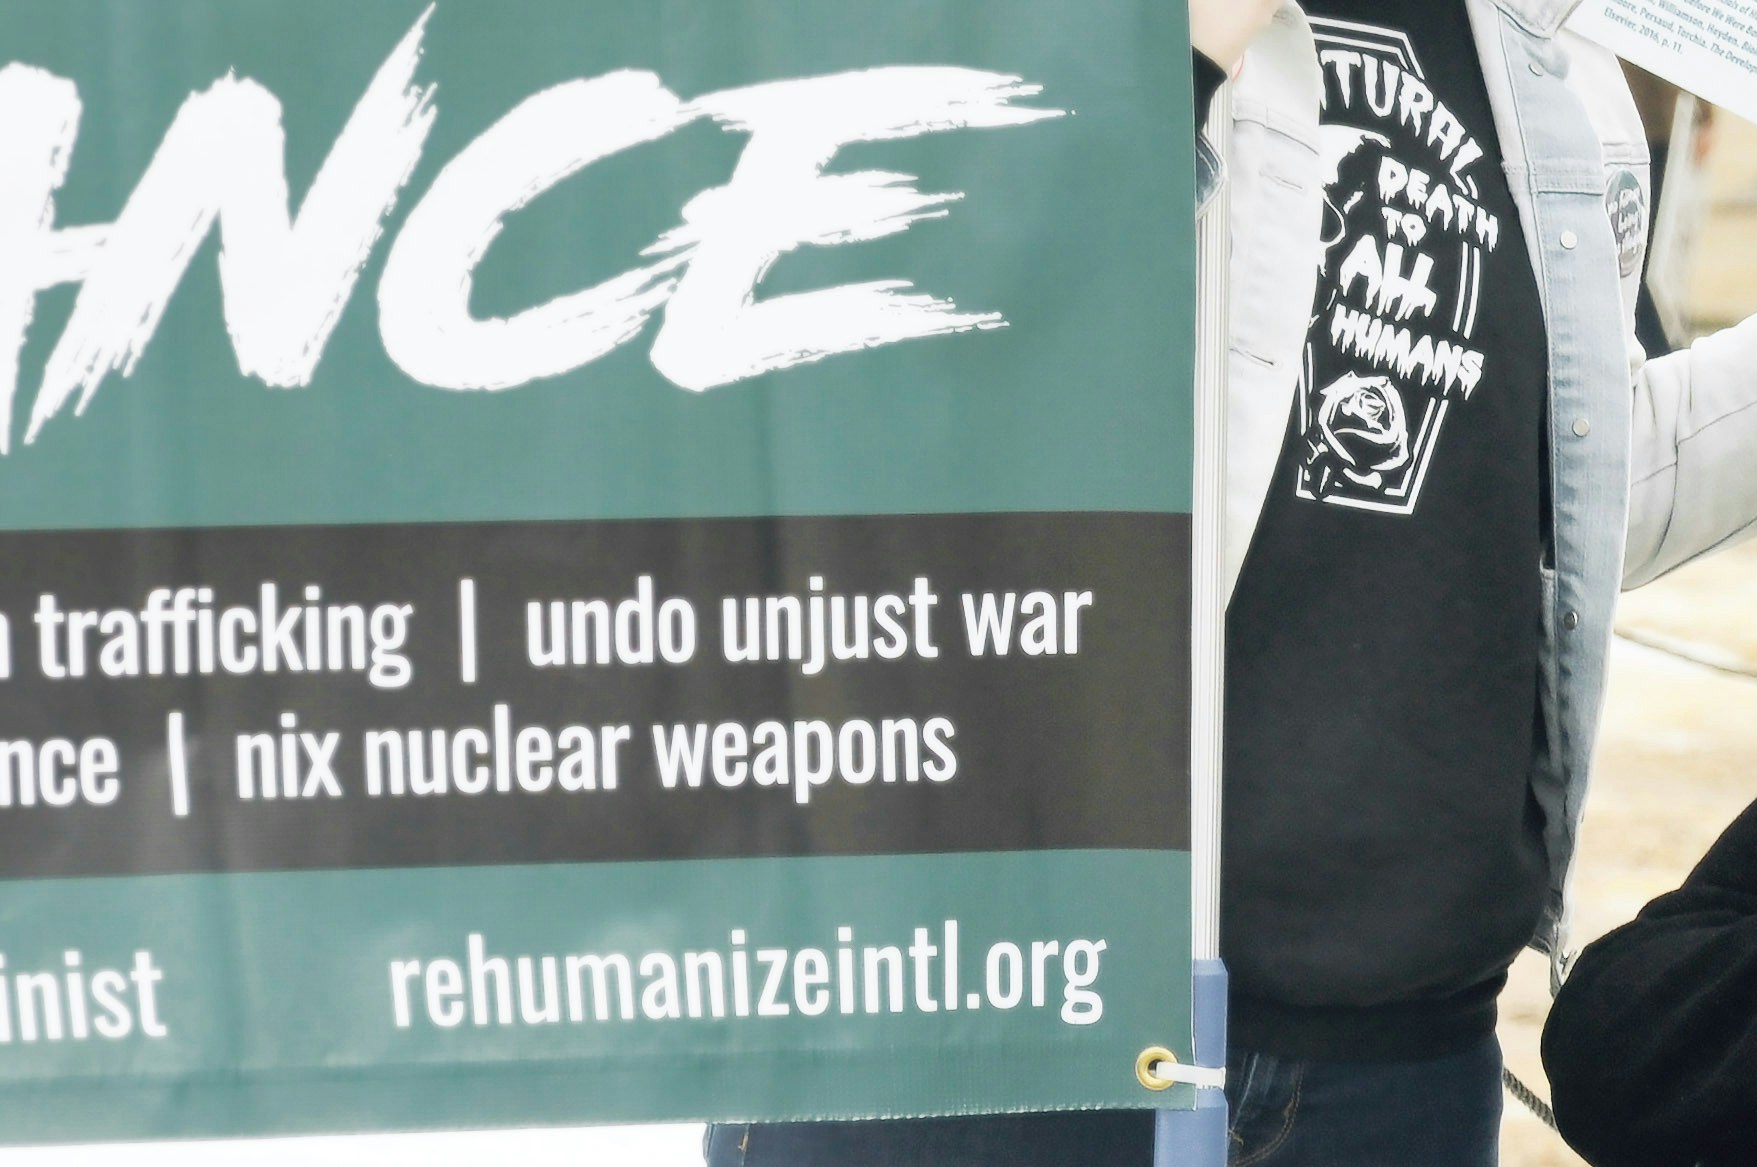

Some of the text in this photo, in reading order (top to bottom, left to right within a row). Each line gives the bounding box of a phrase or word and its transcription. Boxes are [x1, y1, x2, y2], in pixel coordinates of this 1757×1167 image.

[1319, 50, 1484, 195] TURAL
[1378, 156, 1499, 253] DEATH
[1381, 206, 1426, 247] TO
[1340, 234, 1437, 321] ALL
[1331, 303, 1485, 401] HUMANS
[35, 584, 413, 687] trafficking
[528, 576, 695, 666] undo
[723, 577, 938, 674] unjust
[962, 592, 1092, 655] war
[237, 713, 341, 798] nix
[366, 705, 630, 795] nuclear
[653, 718, 956, 803] weapons
[391, 920, 1106, 1027] rehumanizeintl.org
